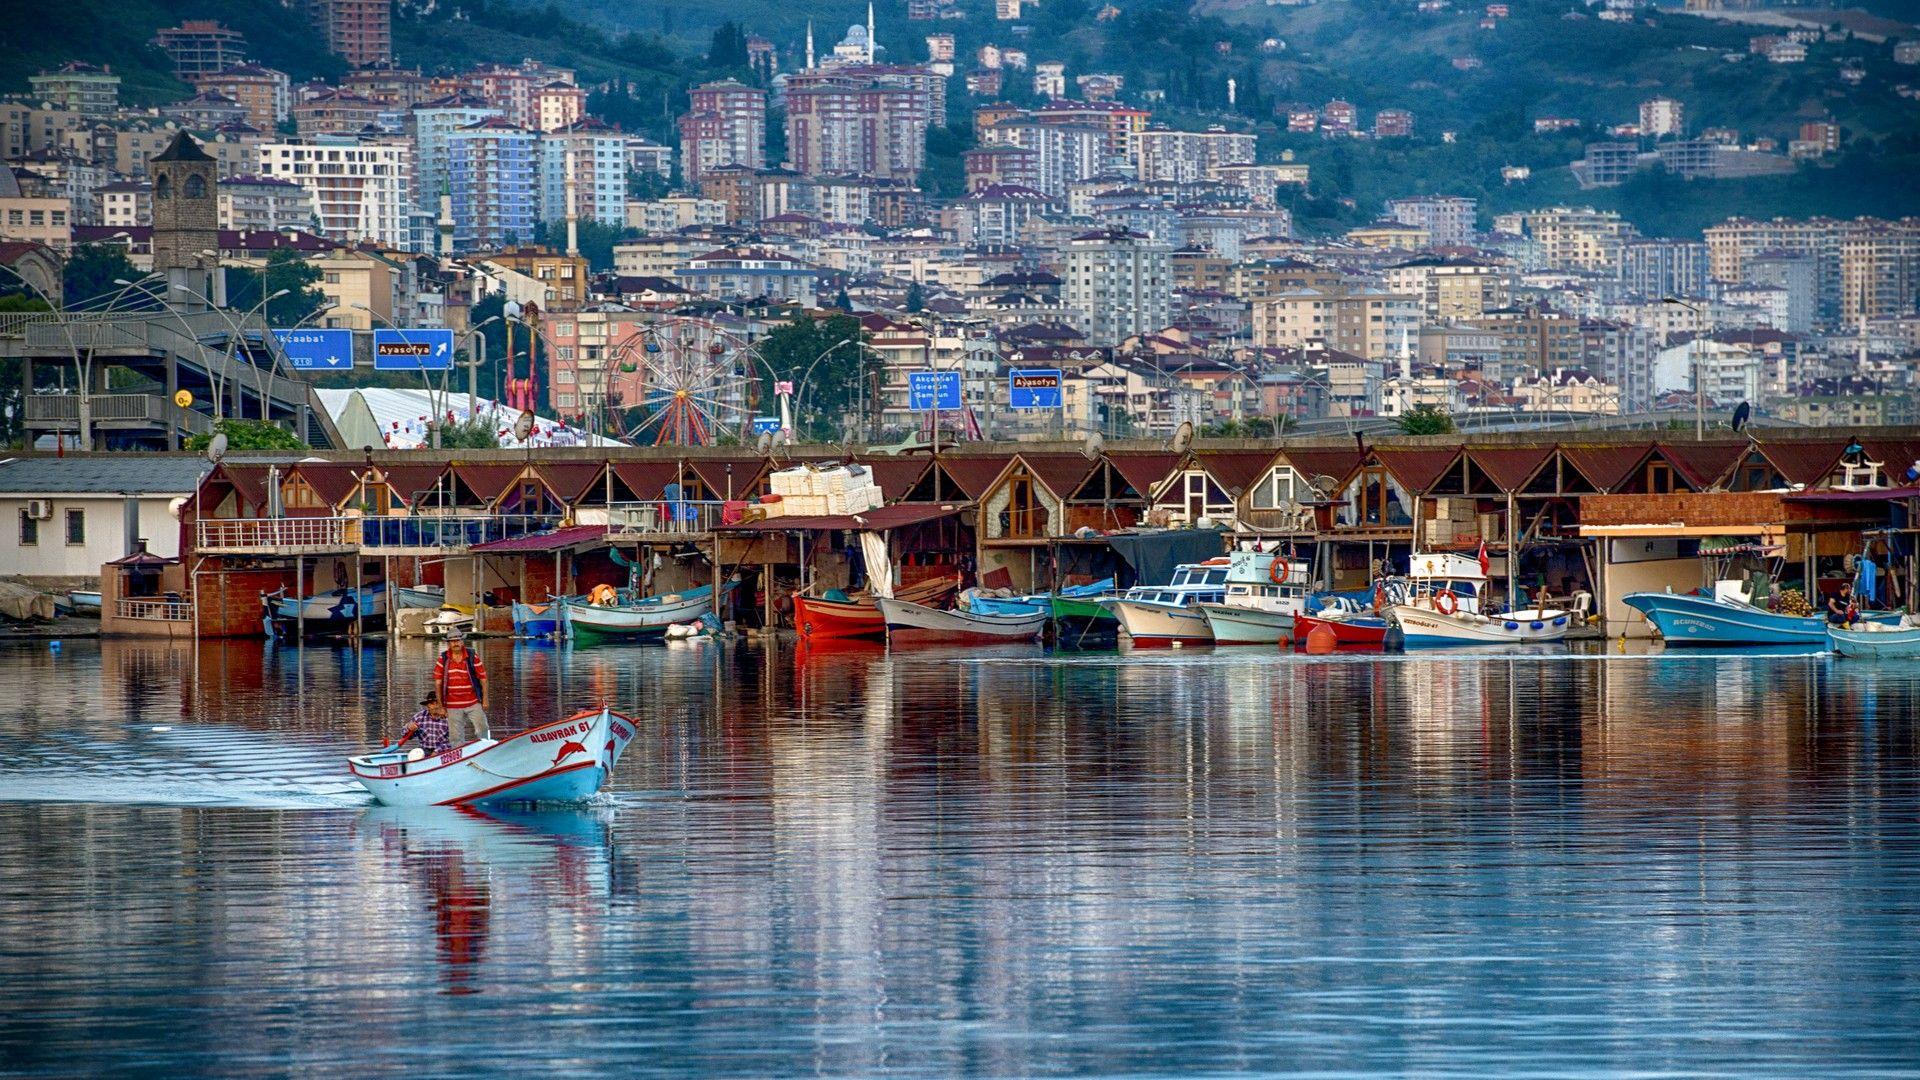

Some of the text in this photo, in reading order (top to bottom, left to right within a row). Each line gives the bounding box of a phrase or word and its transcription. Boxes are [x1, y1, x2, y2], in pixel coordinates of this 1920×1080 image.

[380, 345, 430, 355] Ayasofya
[1016, 378, 1056, 387] Ayasofya
[529, 720, 591, 744] ALBAYRAK 61
